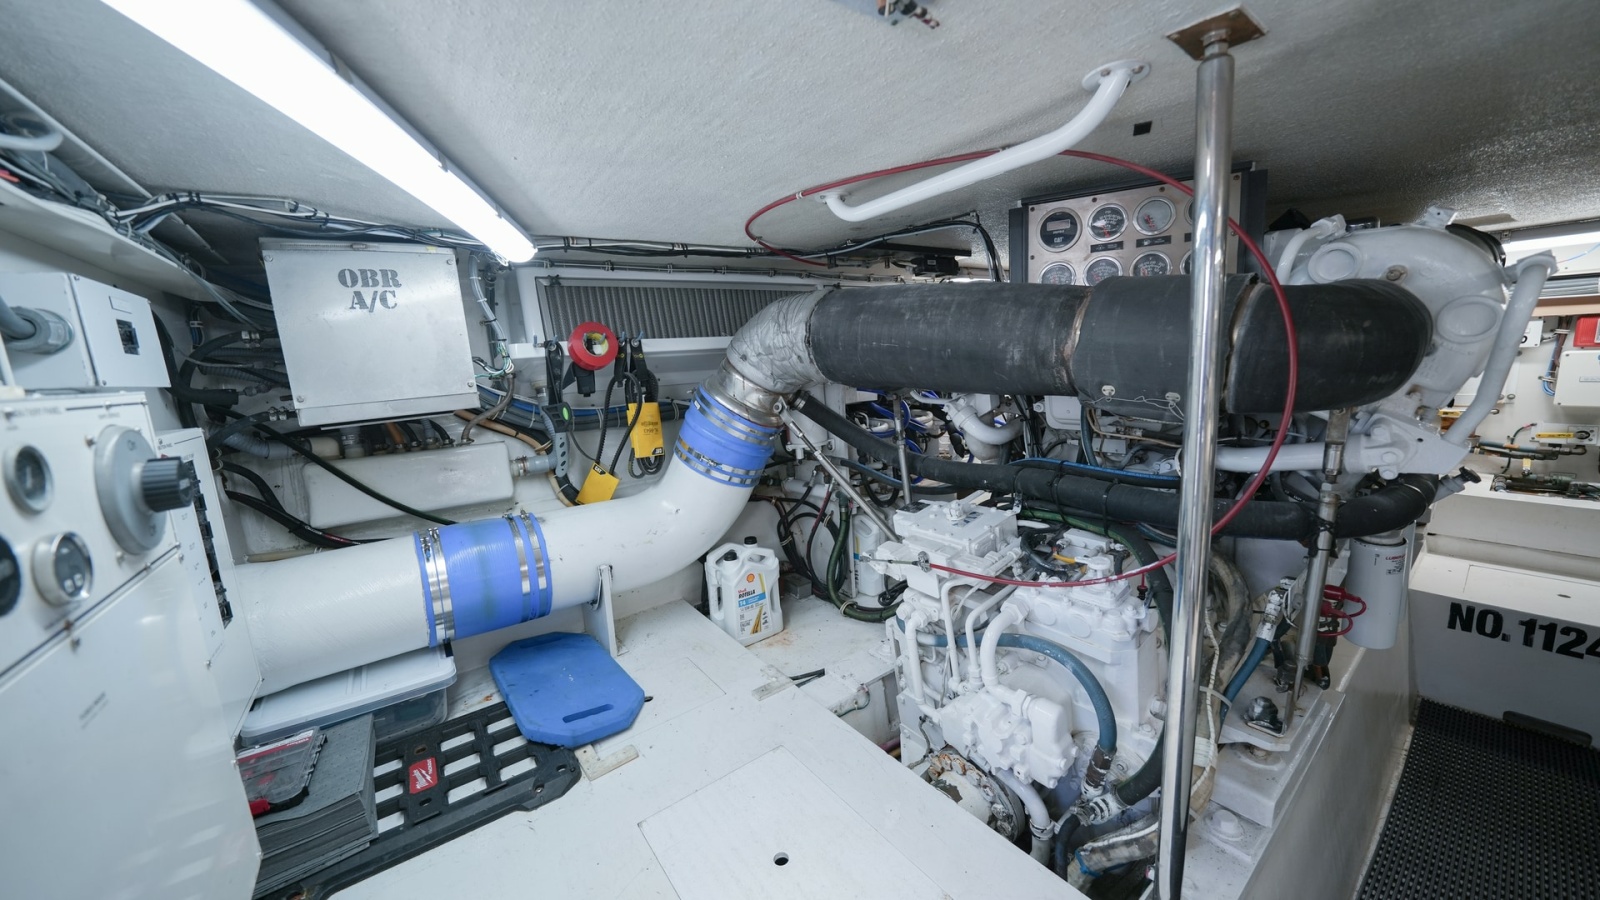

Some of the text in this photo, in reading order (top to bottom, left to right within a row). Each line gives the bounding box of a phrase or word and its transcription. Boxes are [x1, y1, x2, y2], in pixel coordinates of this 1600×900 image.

[337, 268, 402, 288] OBR
[349, 290, 398, 313] A/C
[739, 590, 755, 598] ROTELLA
[1447, 602, 1511, 642] NO.
